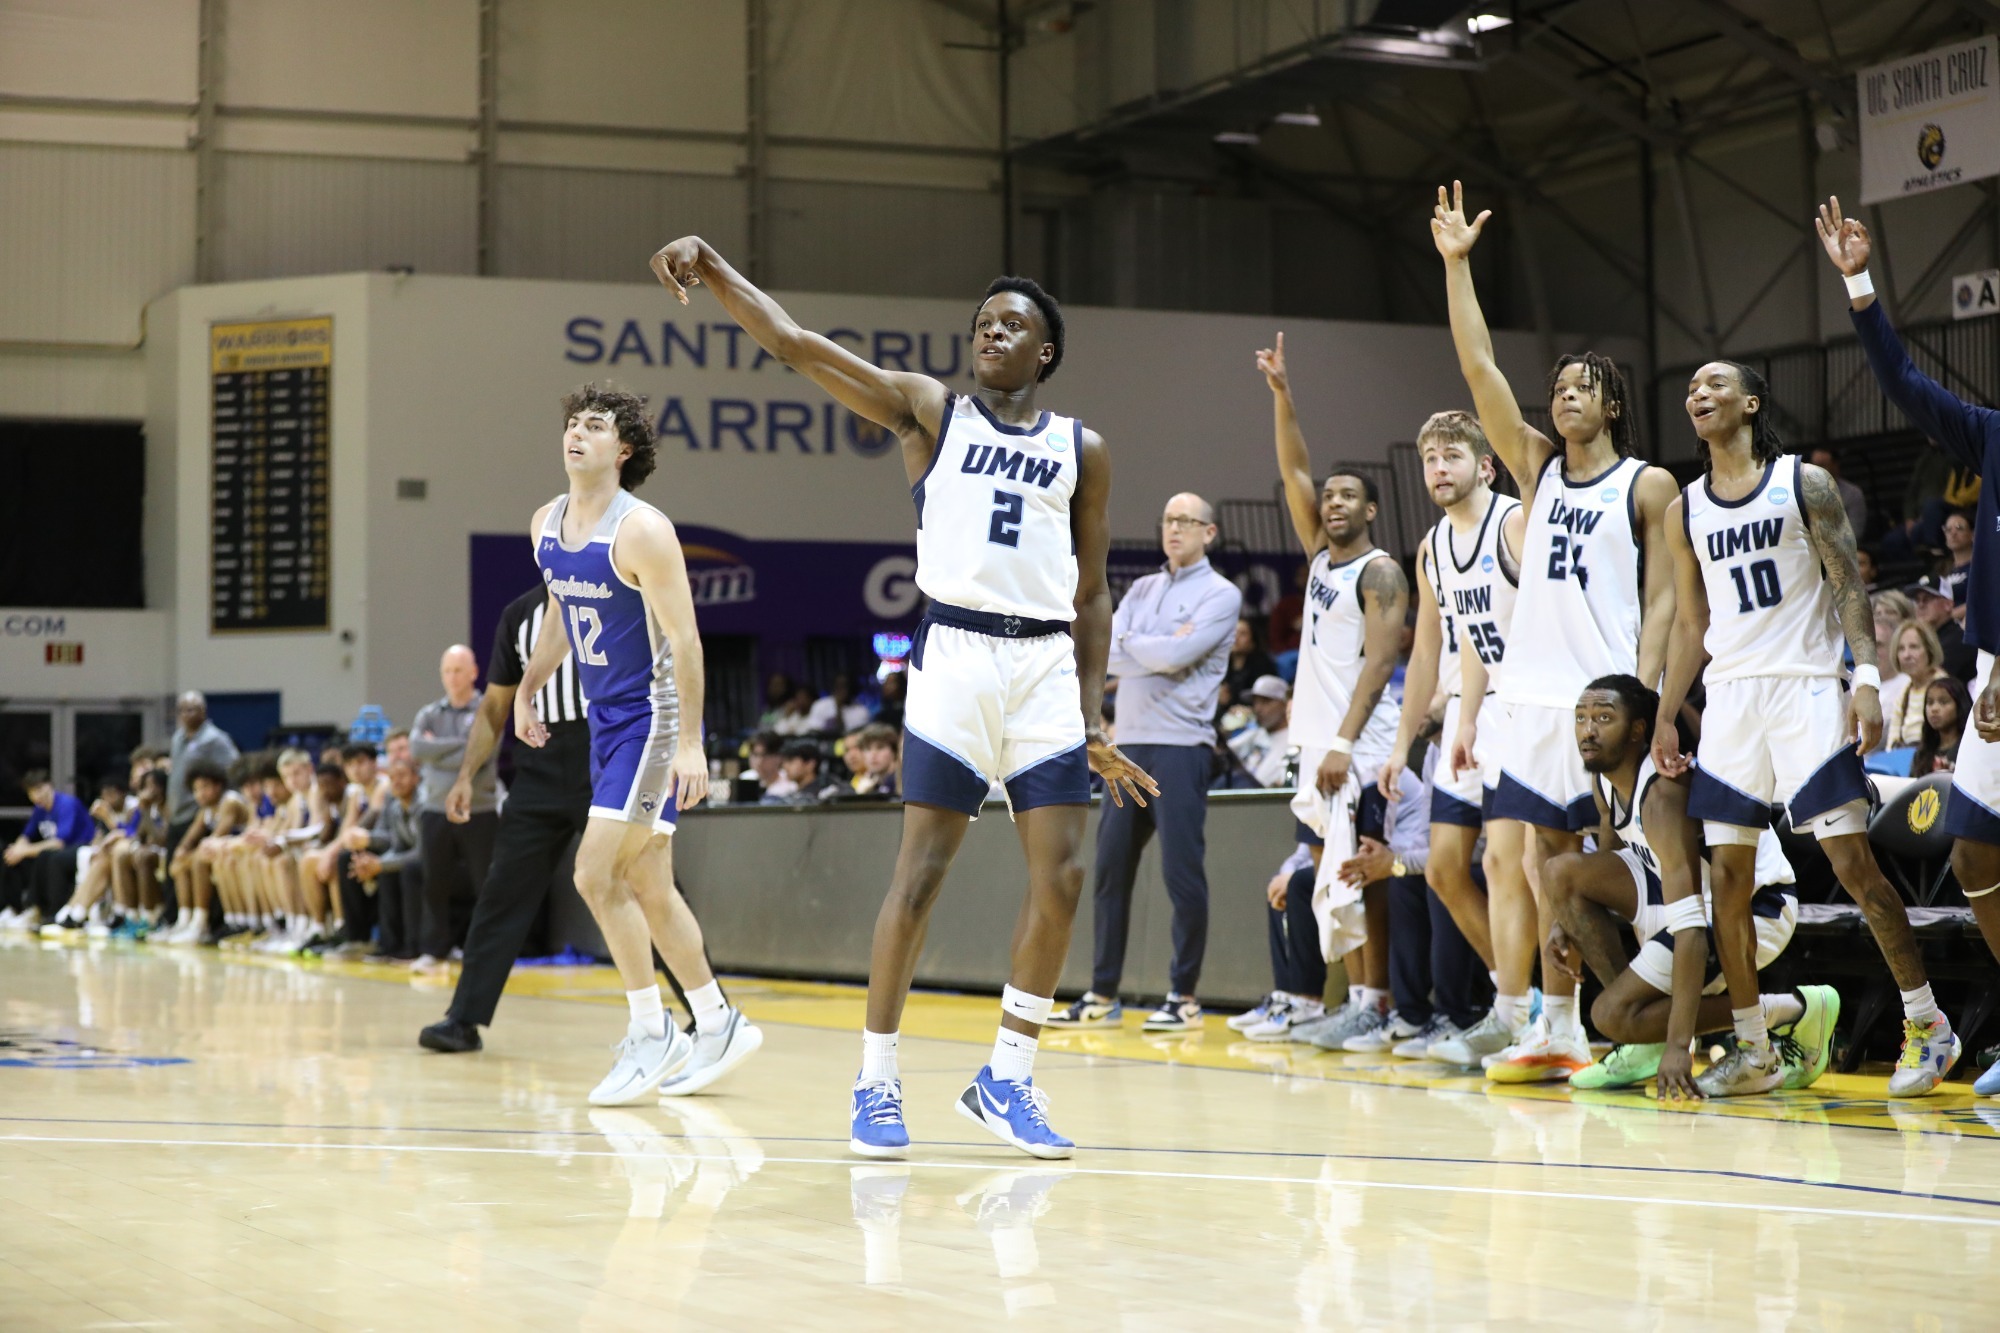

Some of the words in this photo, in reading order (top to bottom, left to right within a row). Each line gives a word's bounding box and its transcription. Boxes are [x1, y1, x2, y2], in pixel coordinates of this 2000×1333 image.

[1867, 72, 1888, 116] UC
[1892, 58, 1943, 110] SANTA
[1947, 46, 1989, 95] CRUZ
[824, 328, 976, 378] RU
[960, 443, 1063, 489] UMW
[986, 488, 1025, 550] 2
[1706, 517, 1784, 561] UMW
[543, 567, 613, 602] Captains
[1547, 534, 1589, 591] 24
[1729, 558, 1784, 614] 10
[1453, 584, 1491, 615] UMW
[568, 604, 609, 667] 12
[1467, 621, 1506, 664] 25
[1623, 840, 1657, 868] MW
